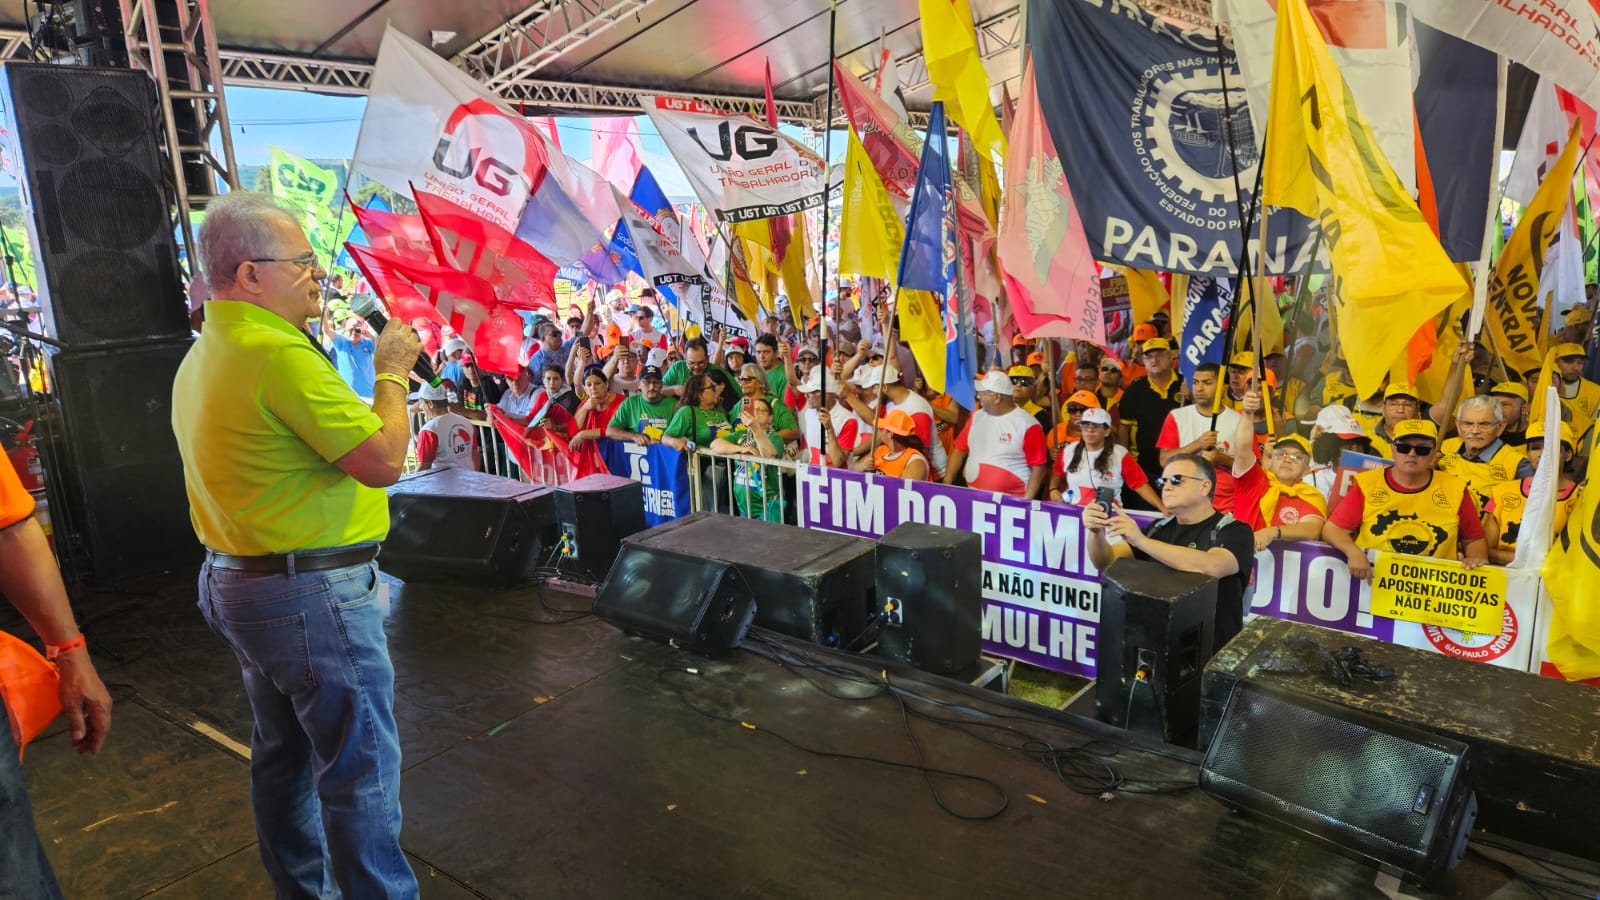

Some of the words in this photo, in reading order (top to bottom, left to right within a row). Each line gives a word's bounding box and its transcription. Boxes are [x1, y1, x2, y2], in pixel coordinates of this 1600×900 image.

[665, 98, 691, 110] UGT
[1132, 131, 1146, 156] DOS
[1177, 56, 1203, 69] NAS
[748, 160, 793, 176] GERAL
[470, 193, 512, 222] GERAL
[738, 207, 761, 219] UGT
[781, 201, 802, 213] UGT
[1158, 198, 1206, 228] ESTADO
[1207, 219, 1227, 231] DO
[1208, 207, 1227, 218] DO
[808, 474, 886, 537] FIM
[998, 571, 1035, 600] NÃO
[1390, 562, 1399, 577] O
[1401, 564, 1468, 587] CONFISCO
[1469, 574, 1488, 589] DE
[1378, 576, 1500, 608] APOSENTADOS/AS
[1394, 593, 1422, 611] NÃO
[1423, 597, 1432, 613] É
[1433, 601, 1478, 620] JUSTO
[1462, 650, 1489, 659] PAULO
